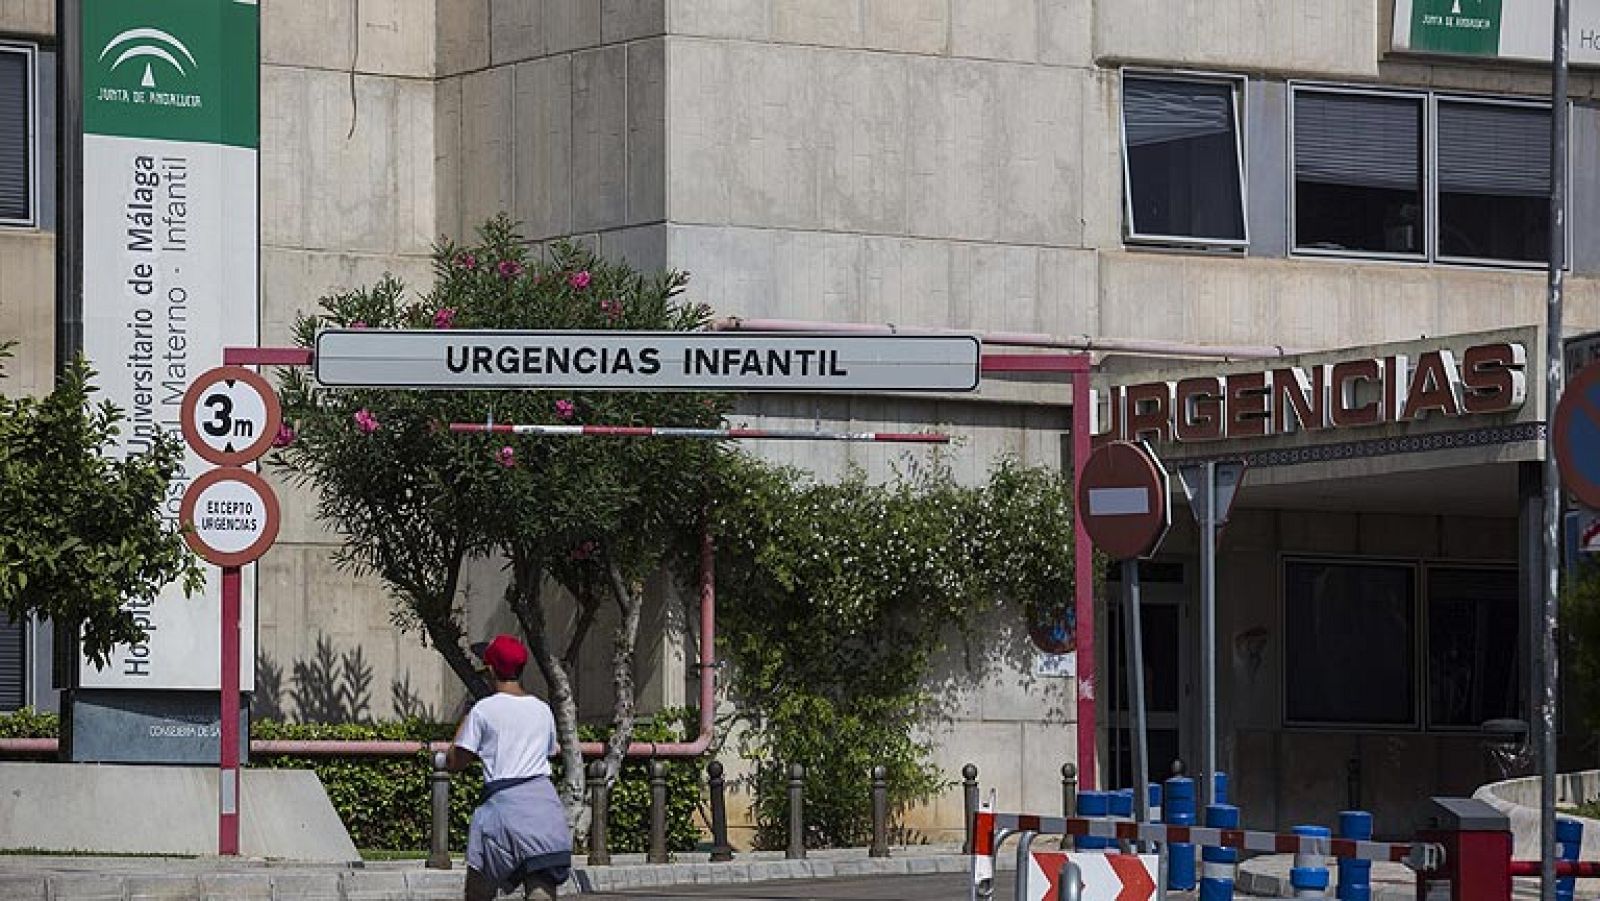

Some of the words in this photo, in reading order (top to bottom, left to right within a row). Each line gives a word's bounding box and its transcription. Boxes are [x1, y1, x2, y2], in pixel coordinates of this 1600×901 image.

[98, 87, 129, 103] JUNTA
[133, 91, 146, 103] DE
[126, 155, 160, 252] Málaga
[161, 157, 187, 251] Infantil
[127, 262, 153, 295] de
[161, 287, 187, 406] Materno
[446, 345, 661, 375] URGENCIAS
[684, 347, 848, 376] INFANTIL
[126, 308, 153, 458] Universitario
[201, 517, 257, 532] URGENCIAS
[207, 500, 253, 516] EXCEPTO
